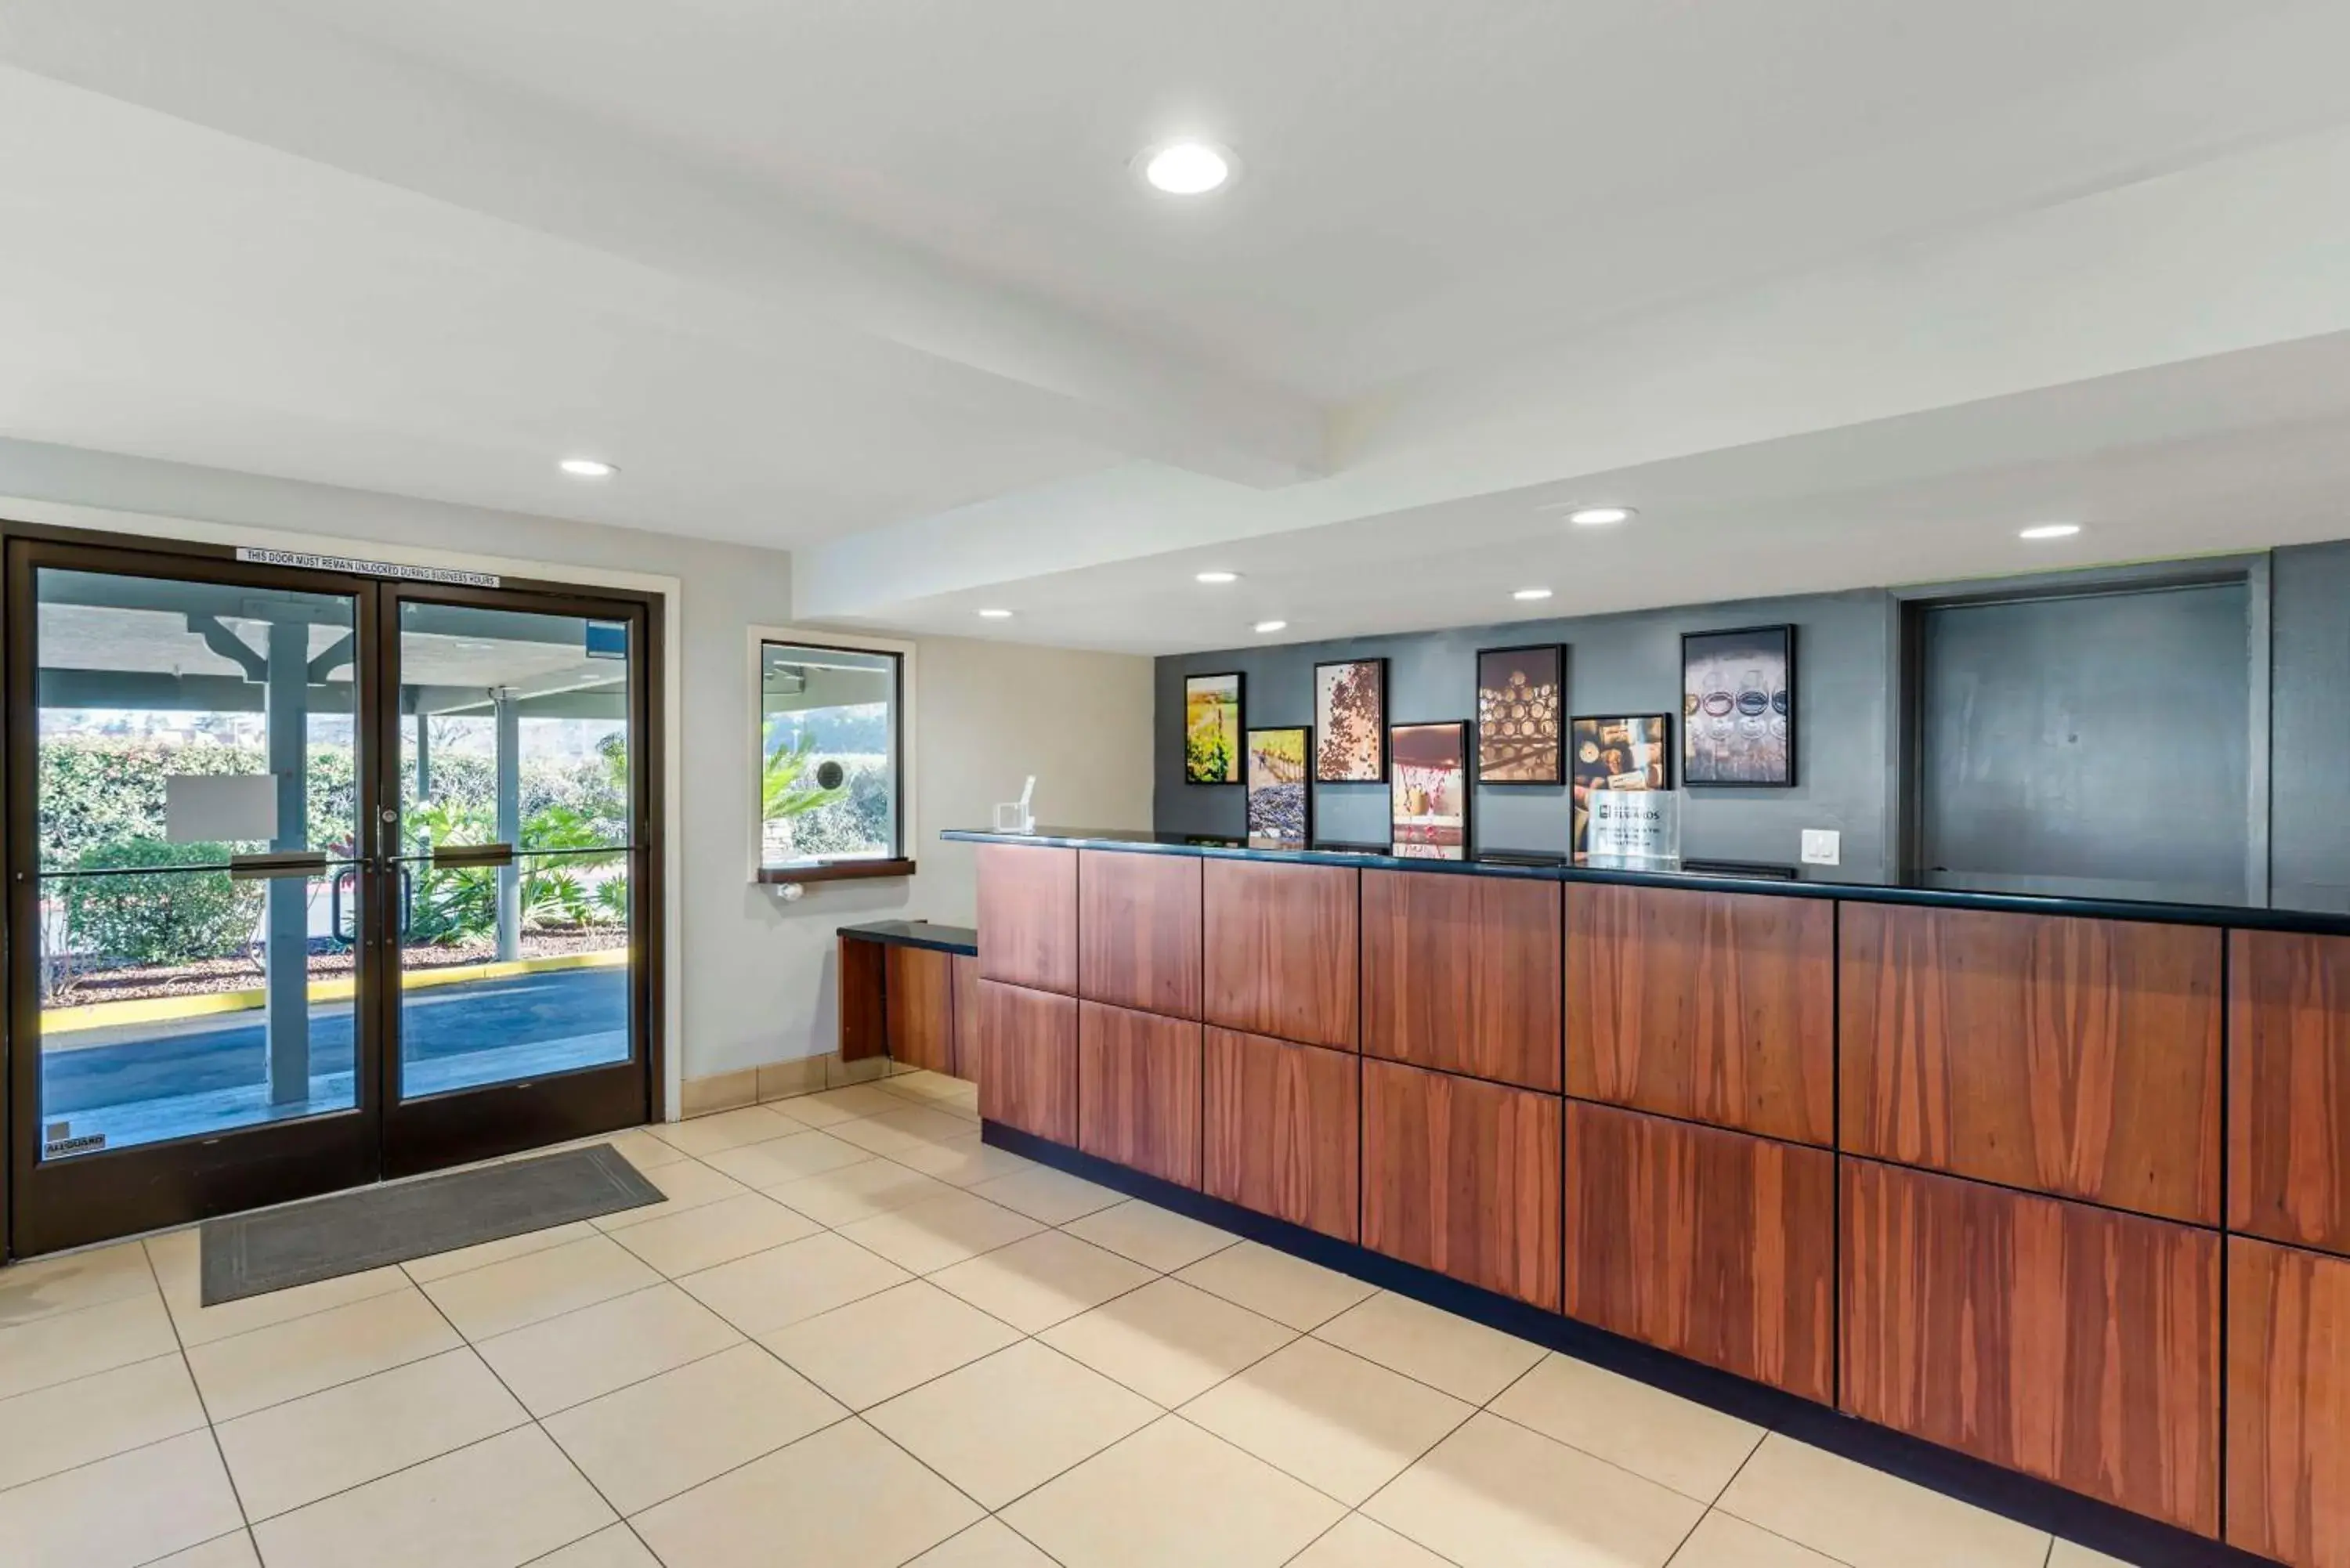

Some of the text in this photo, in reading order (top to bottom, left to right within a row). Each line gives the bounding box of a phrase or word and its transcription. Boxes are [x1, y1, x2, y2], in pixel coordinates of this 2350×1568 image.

[248, 551, 266, 562] THIS
[269, 552, 294, 564] DOOR
[296, 555, 320, 567] MUST
[322, 558, 353, 570] REMAIN
[355, 562, 399, 575] UNLOCKED
[400, 566, 430, 579] DURING
[432, 569, 468, 582] BUSINESS
